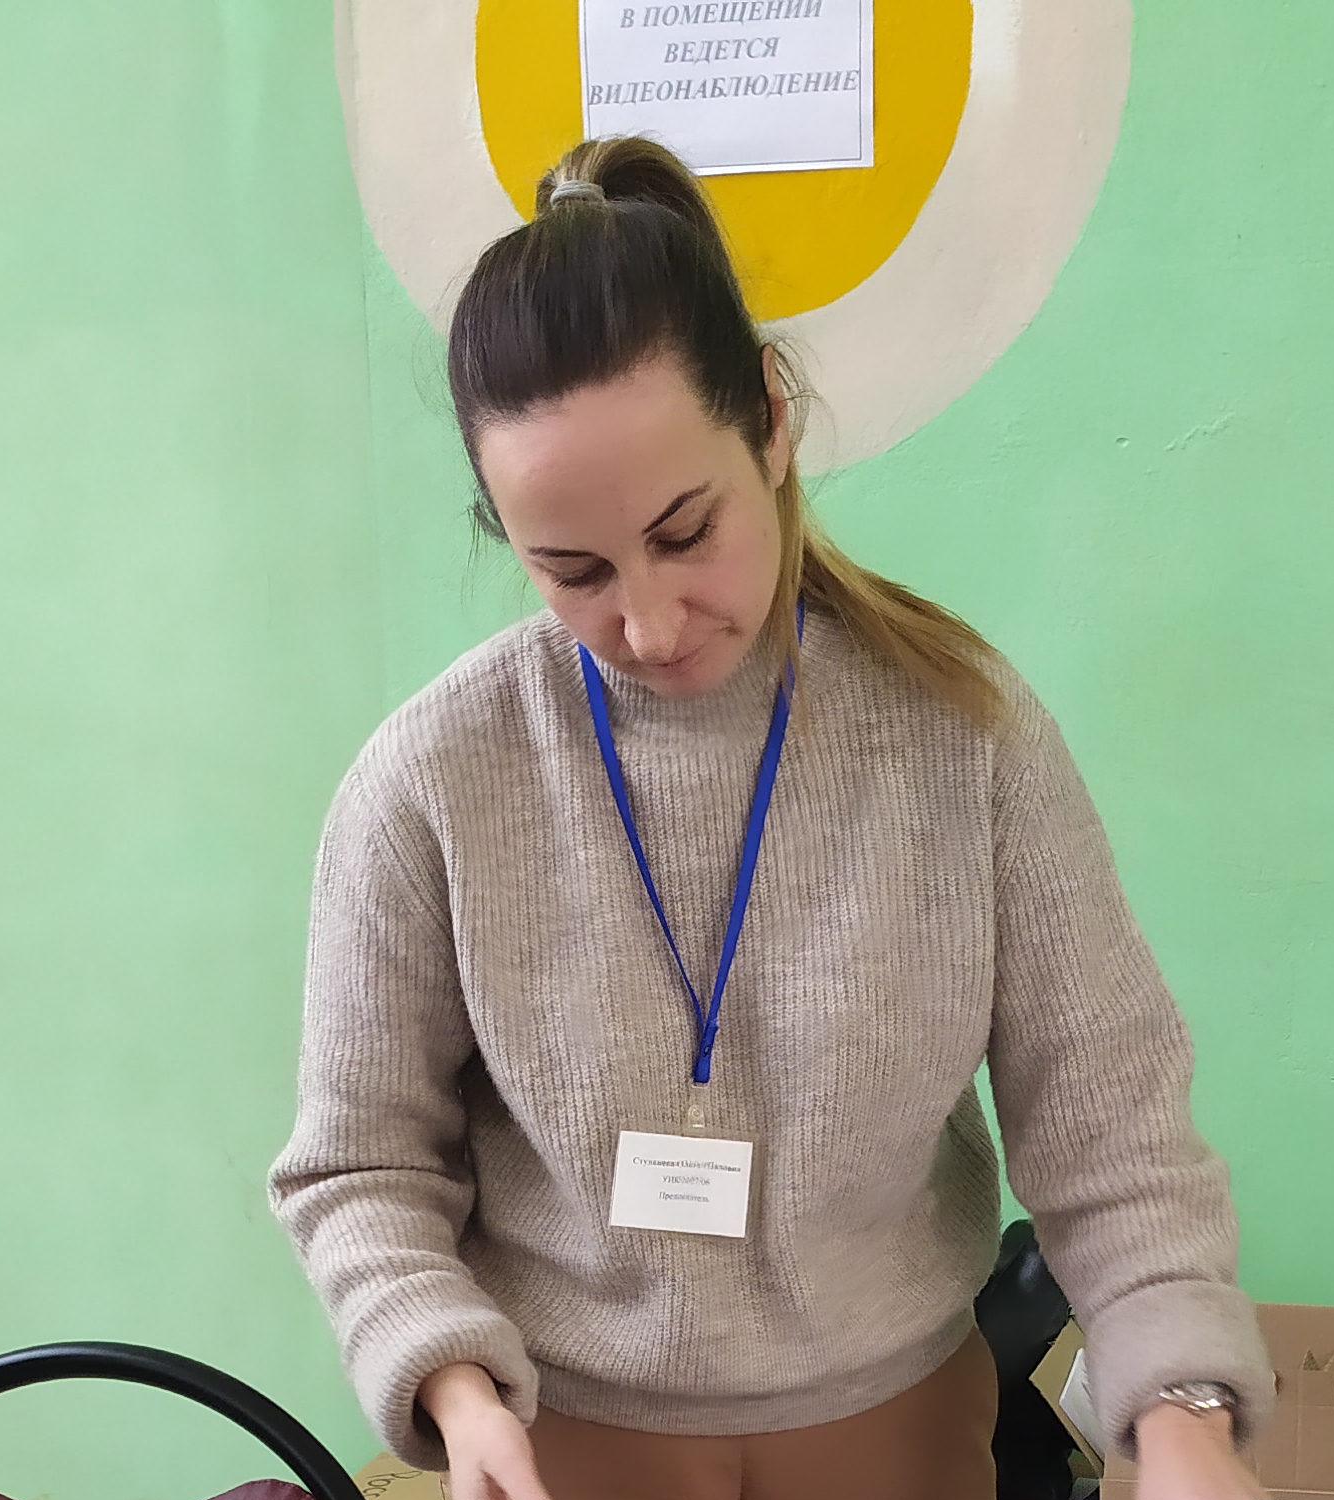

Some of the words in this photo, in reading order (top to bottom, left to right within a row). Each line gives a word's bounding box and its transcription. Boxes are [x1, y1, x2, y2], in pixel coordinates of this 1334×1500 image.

[620, 8, 636, 29] В
[642, 0, 824, 28] ПОМЕЩЕНИИ
[664, 36, 781, 65] ВЕДЕТСЯ
[588, 69, 860, 106] ВИДЕОНАБЛЮДЕНИЕ
